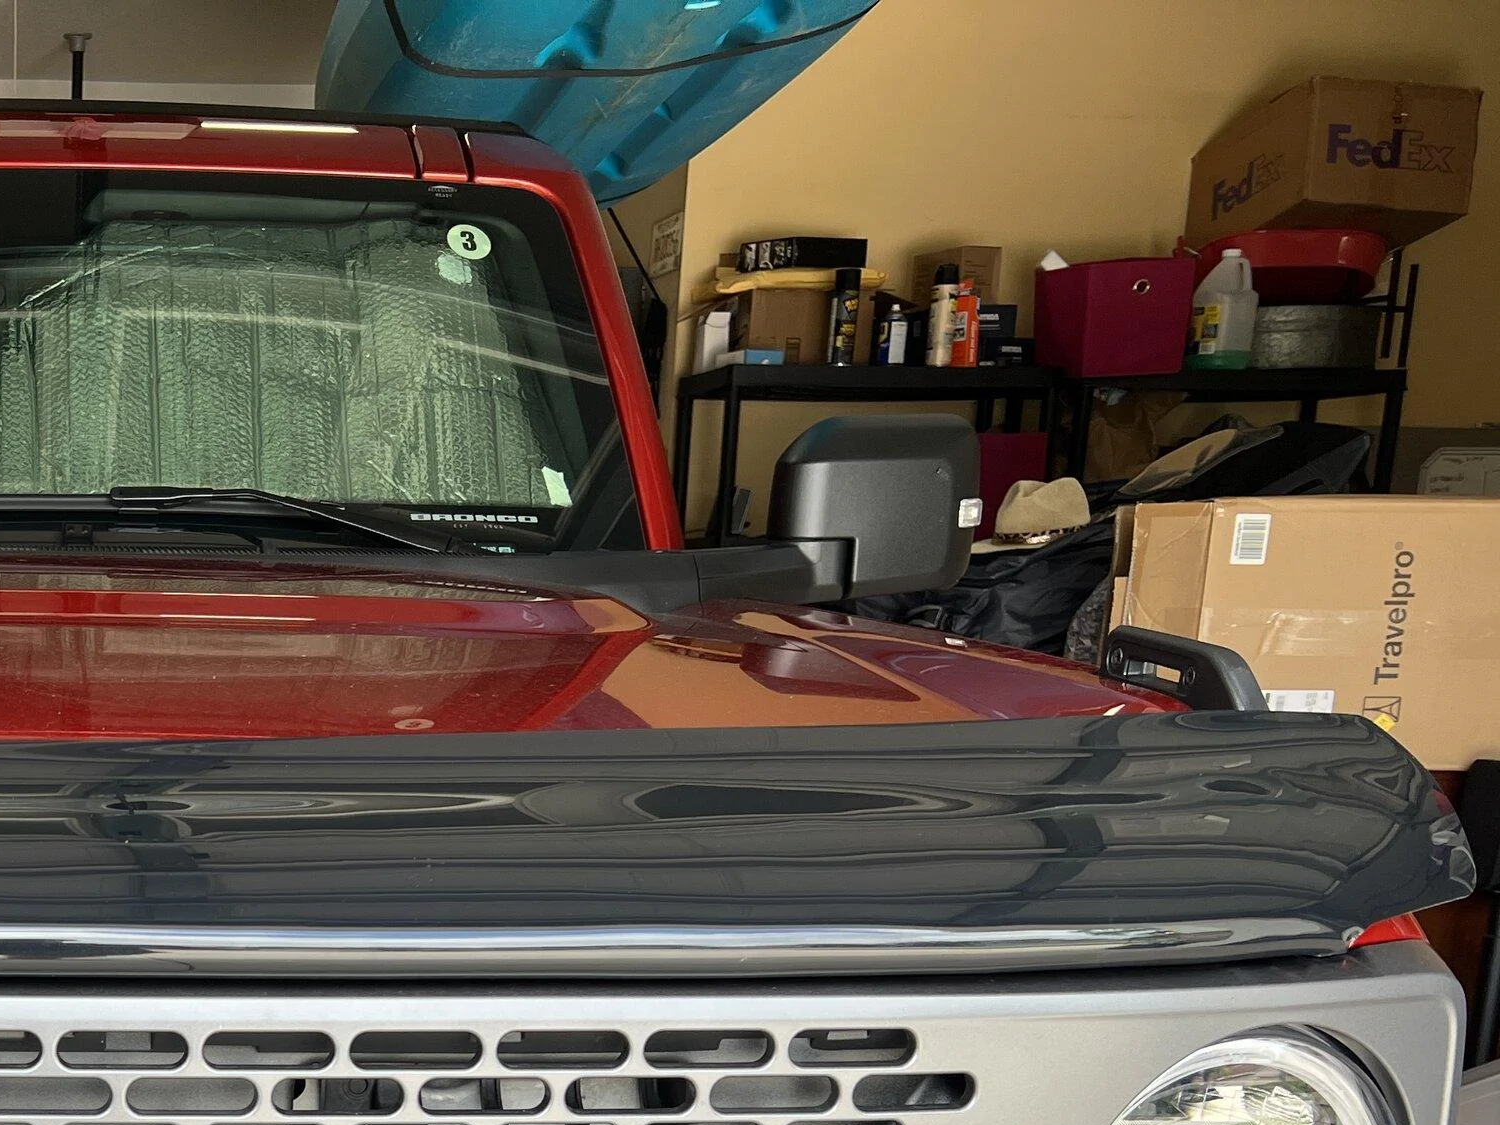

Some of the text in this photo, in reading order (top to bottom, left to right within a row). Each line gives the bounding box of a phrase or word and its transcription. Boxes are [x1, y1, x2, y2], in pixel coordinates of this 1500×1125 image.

[1325, 123, 1457, 174] FedEx
[1210, 152, 1286, 223] FedEx
[460, 230, 478, 252] 3
[410, 513, 539, 524] BRONCO
